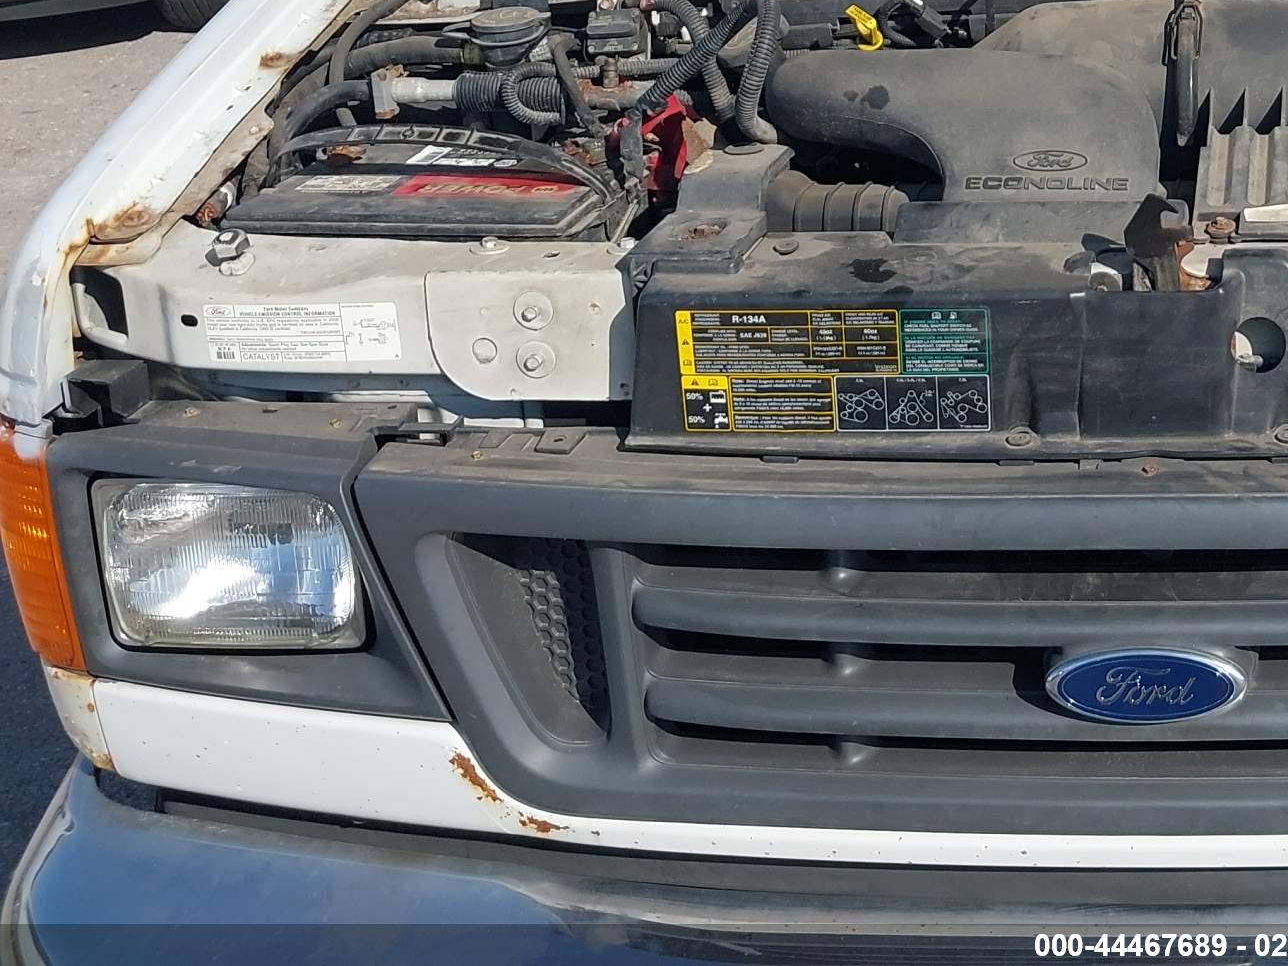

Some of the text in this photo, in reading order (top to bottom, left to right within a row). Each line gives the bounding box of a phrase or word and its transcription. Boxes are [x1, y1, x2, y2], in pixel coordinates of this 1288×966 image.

[1027, 152, 1074, 168] Ford
[965, 176, 1129, 191] ECONOLINE
[415, 183, 524, 195] POWER
[731, 315, 767, 324] R-134A
[242, 353, 280, 362] CATALYST
[686, 392, 704, 401] 50%
[688, 415, 706, 424] 50%
[1095, 666, 1196, 705] Ford
